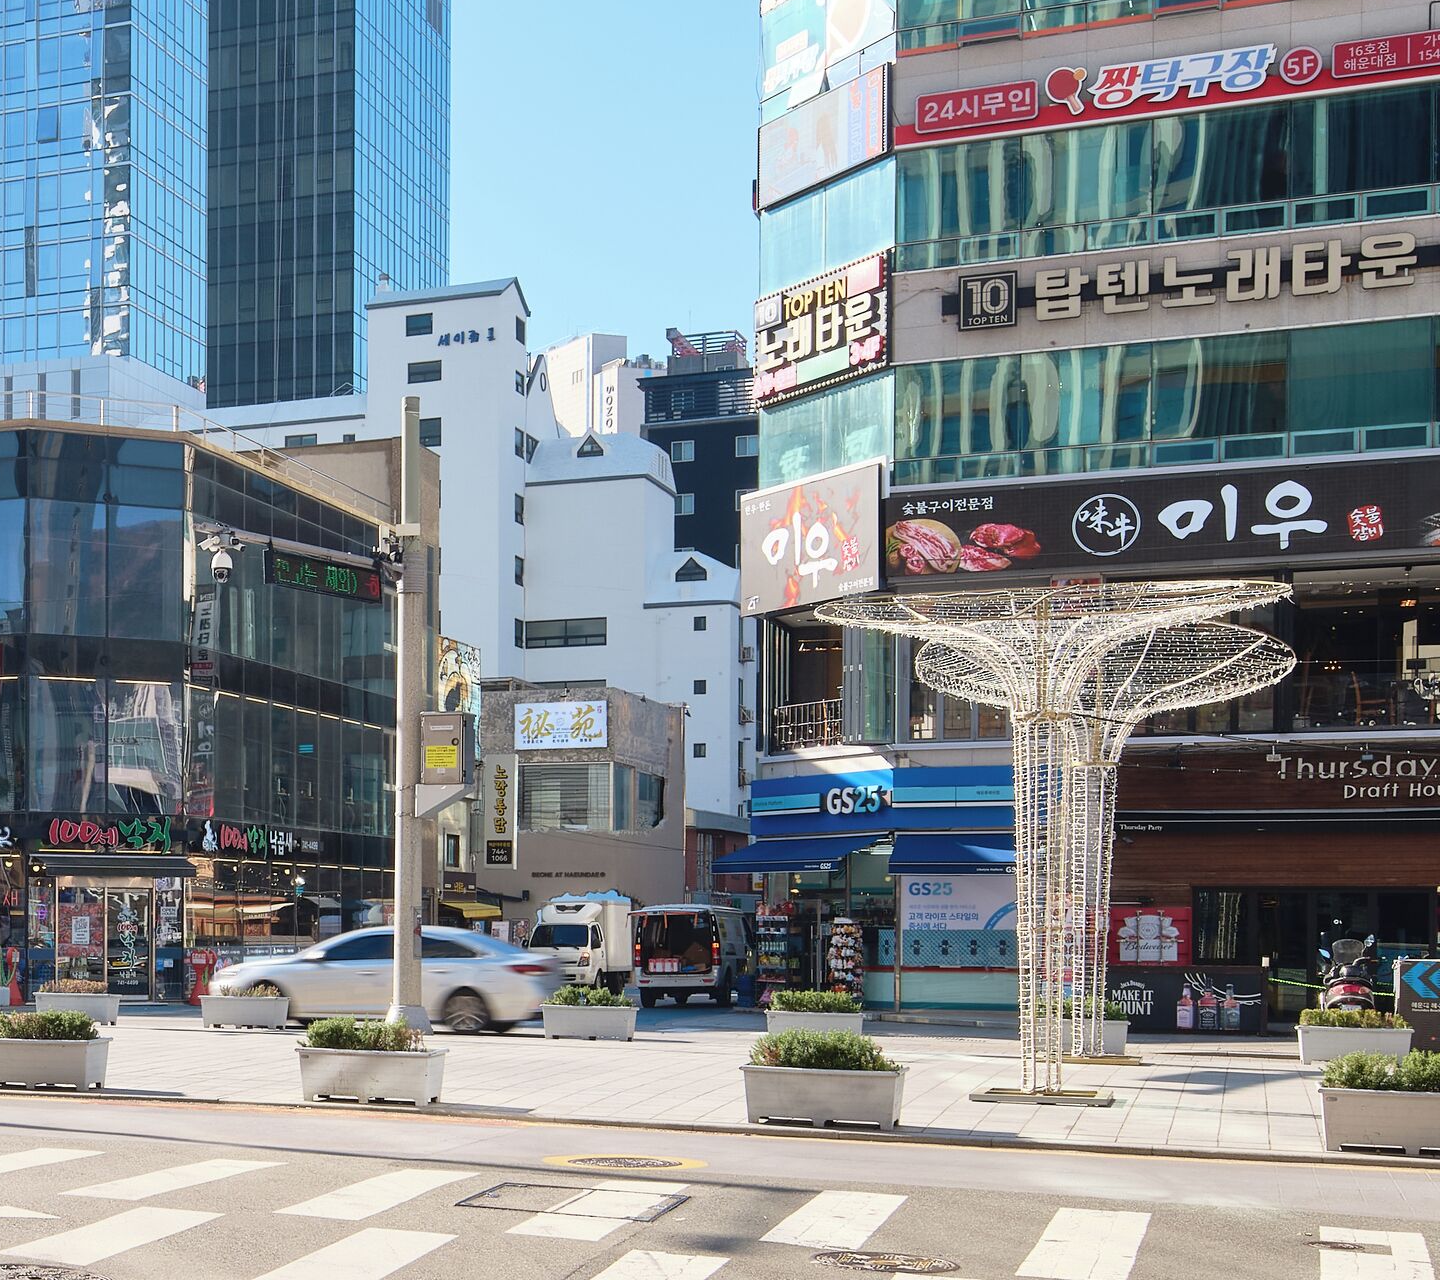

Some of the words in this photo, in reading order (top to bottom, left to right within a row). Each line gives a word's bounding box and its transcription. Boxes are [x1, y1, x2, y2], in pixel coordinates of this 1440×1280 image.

[1348, 41, 1390, 57] 16호점
[1424, 34, 1440, 47] 가
[1286, 54, 1315, 78] 5F
[1344, 53, 1397, 71] 해운대점
[1097, 47, 1274, 106] 짱탁구장
[924, 86, 1031, 124] 24시무인
[1035, 232, 1418, 321] 탑텐노래타운
[967, 278, 1008, 315] 10
[968, 317, 987, 326] TOP
[989, 315, 1008, 324] TEN
[760, 293, 873, 371] 노래타운
[902, 496, 995, 517] 숯불구이전문점
[1157, 480, 1328, 550] 미우
[1350, 505, 1381, 525] 숯불
[1351, 525, 1384, 541] 갈비
[761, 511, 839, 588] 미우
[1277, 754, 1438, 781] Thursday
[826, 785, 882, 815] GS25
[1344, 782, 1400, 799] Draft
[49, 818, 119, 845] 100세
[119, 816, 172, 854] 낙지
[1119, 823, 1147, 831] Thursday
[908, 882, 953, 896] GS25
[908, 912, 923, 921] 고객
[924, 912, 948, 921] 라이프
[948, 912, 979, 921] 스타일의
[1111, 990, 1140, 1001] MAKE
[1143, 990, 1154, 1001] IT
